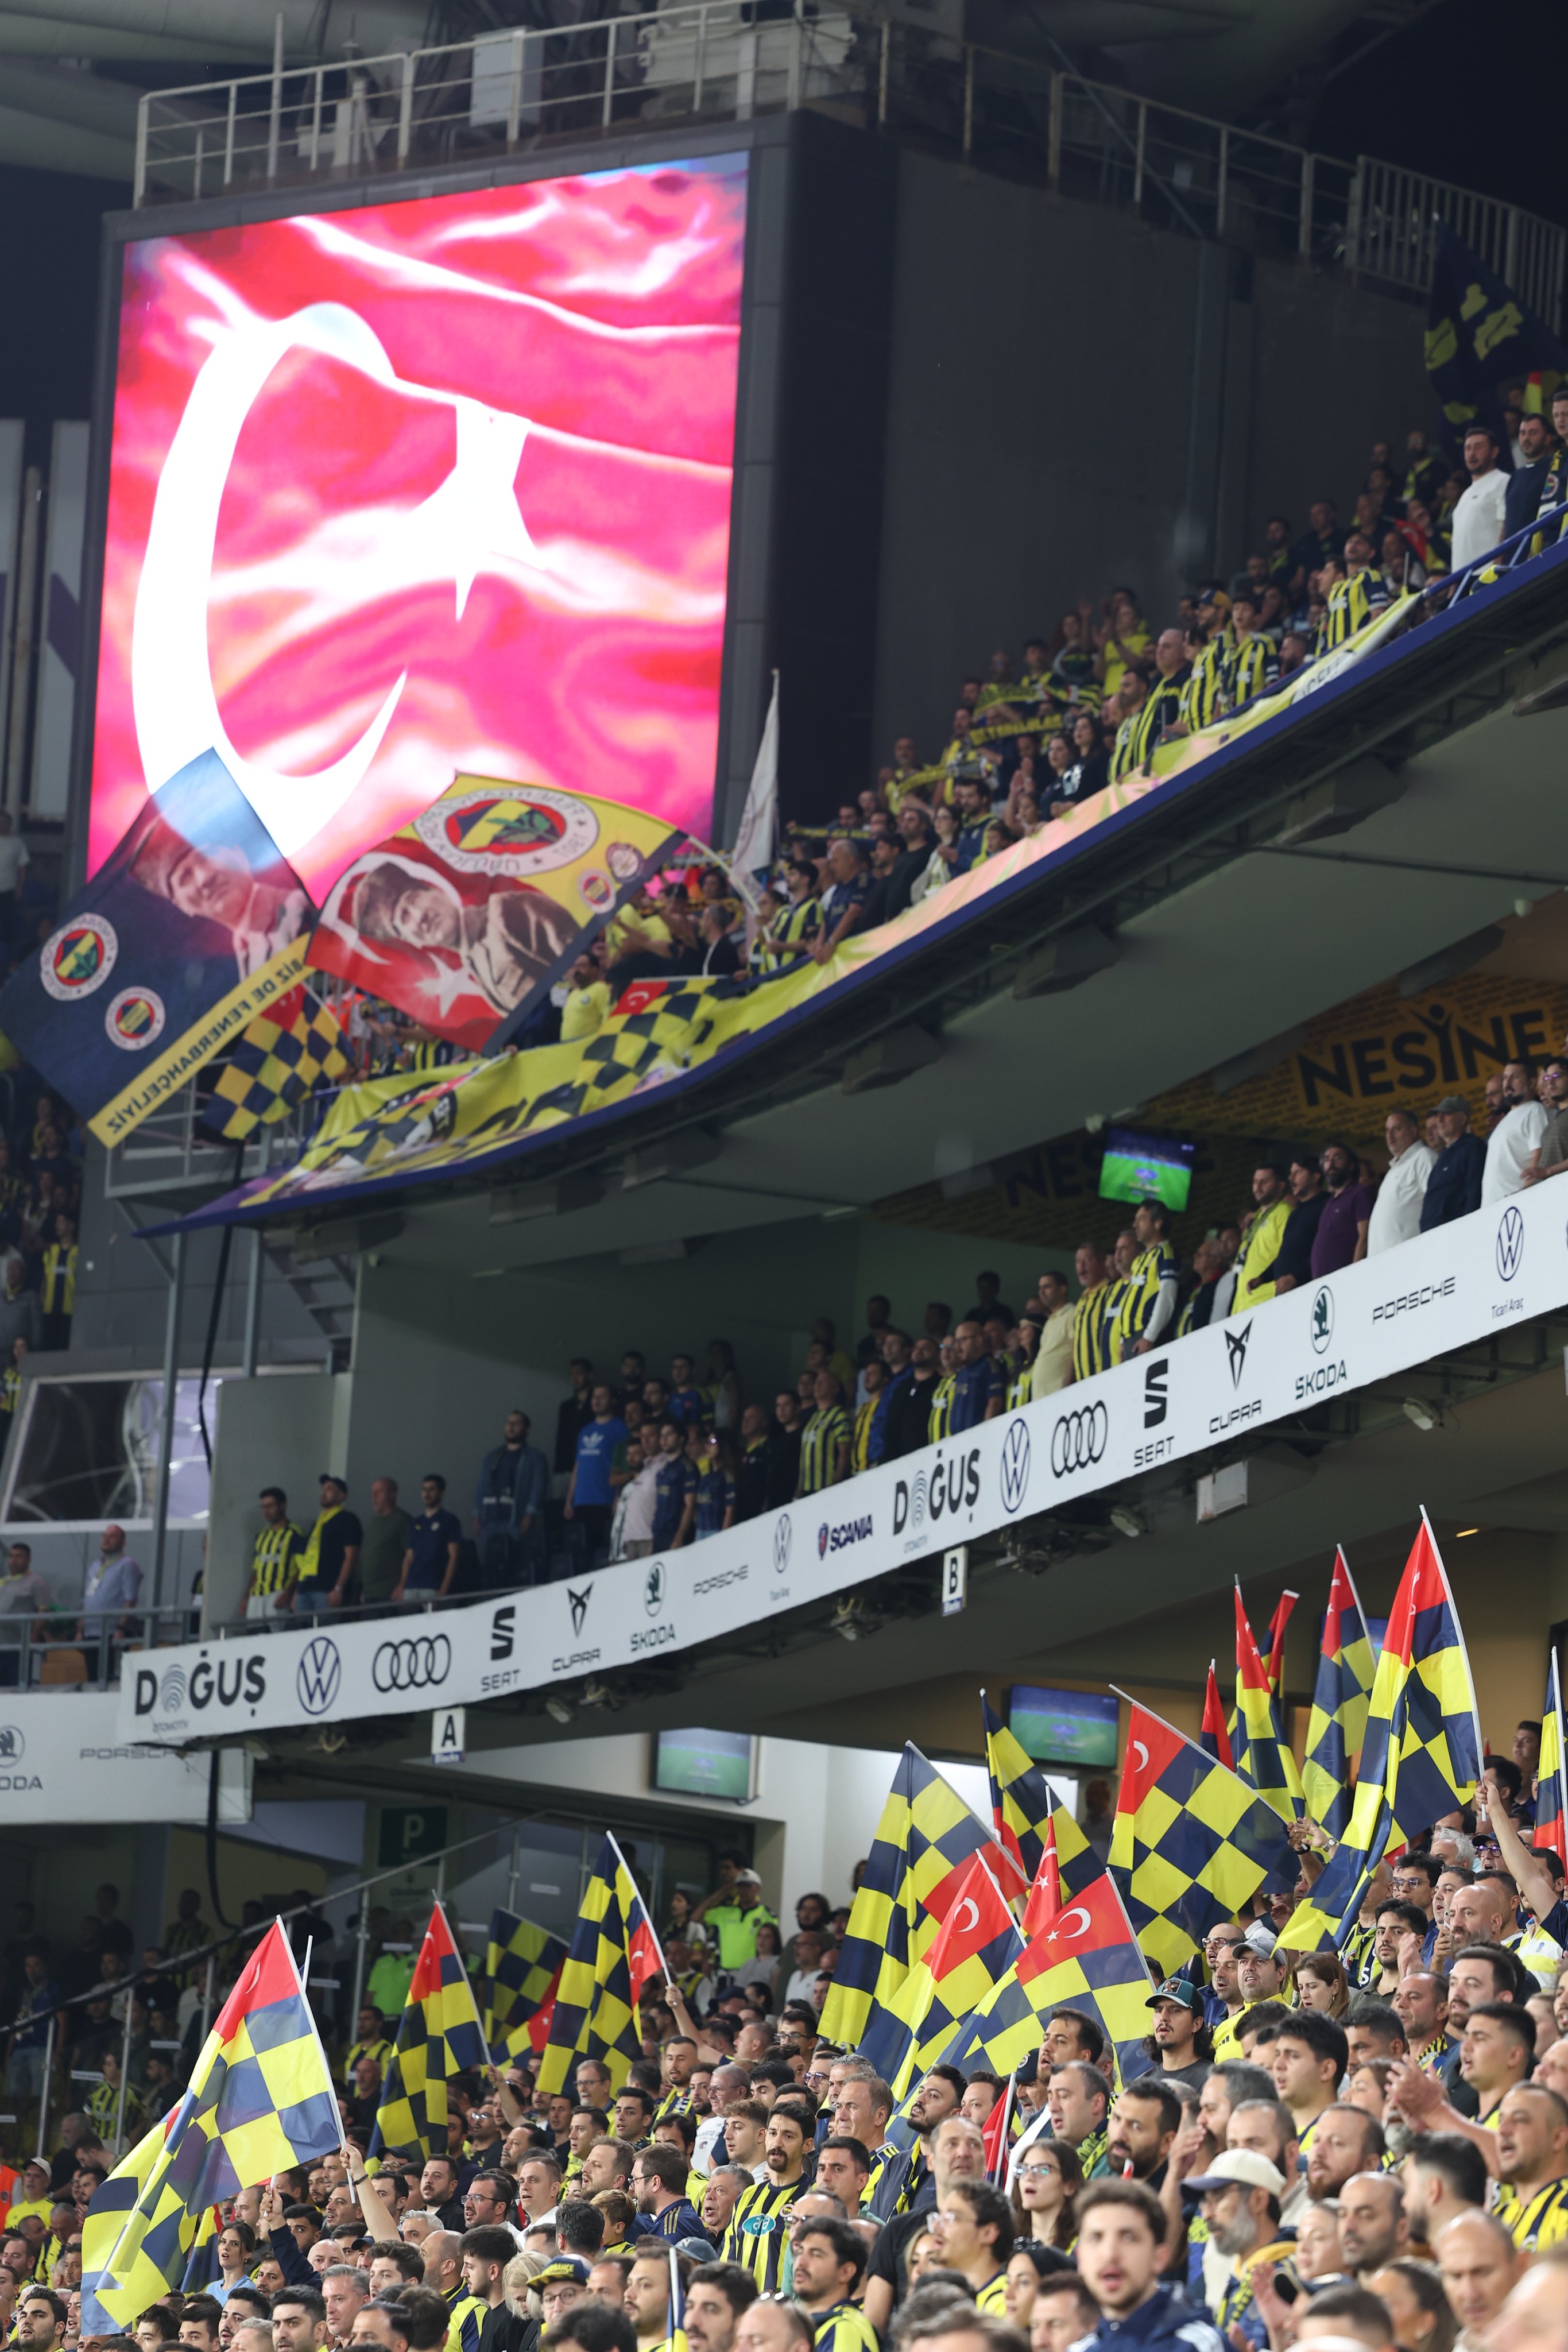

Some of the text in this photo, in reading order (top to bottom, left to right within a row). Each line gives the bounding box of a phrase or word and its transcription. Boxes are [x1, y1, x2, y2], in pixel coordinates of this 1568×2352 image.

[1373, 1276, 1455, 1325] PORSCHE
[1209, 1399, 1262, 1434] CUPRA
[1134, 1436, 1175, 1468] SEAT
[830, 1514, 873, 1552] SCANIA
[693, 1565, 749, 1596] PORSCHE
[949, 1557, 958, 1595] B
[552, 1647, 601, 1672] CUPRA
[481, 1668, 521, 1692] SEAT
[441, 1714, 457, 1747] A
[0, 1775, 43, 1790] ODA
[402, 1814, 424, 1848] P
